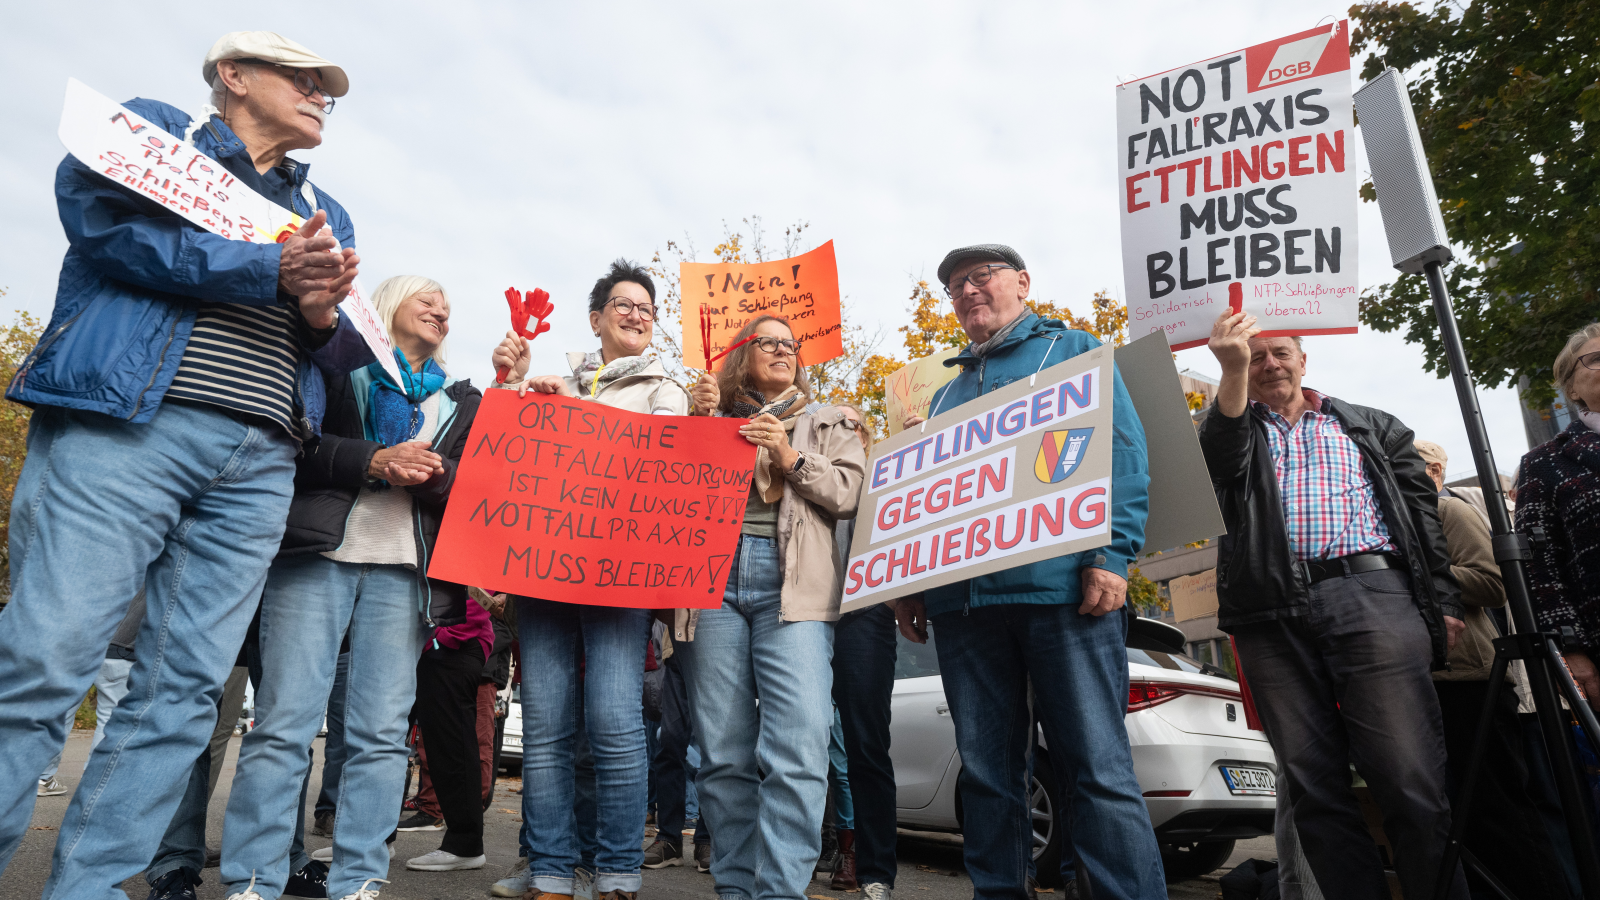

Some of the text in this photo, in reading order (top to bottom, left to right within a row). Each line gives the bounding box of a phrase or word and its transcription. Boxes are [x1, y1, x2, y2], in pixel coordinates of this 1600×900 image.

[1139, 55, 1242, 124] NOT
[1268, 61, 1312, 81] DGB
[1128, 88, 1330, 169] FALLPRAXIS
[141, 144, 229, 202] Praxis
[1126, 130, 1345, 213] ETTLINGEN
[1180, 184, 1297, 240] MUSS
[1147, 226, 1341, 299] BLEIBEN
[737, 291, 814, 313] Schließung
[1136, 292, 1213, 320] Solidarisch
[1265, 301, 1322, 317] überall
[519, 402, 678, 449] ORTSNAHE
[871, 373, 1092, 489] ETTLINGEN
[472, 432, 753, 492] NOTFALLVERSORGUNG
[509, 470, 548, 495] IST
[560, 478, 620, 510] KEIN
[877, 457, 1008, 531] GEGEN
[503, 545, 588, 584] MUSS
[845, 487, 1106, 595] SCHLIEßUNG
